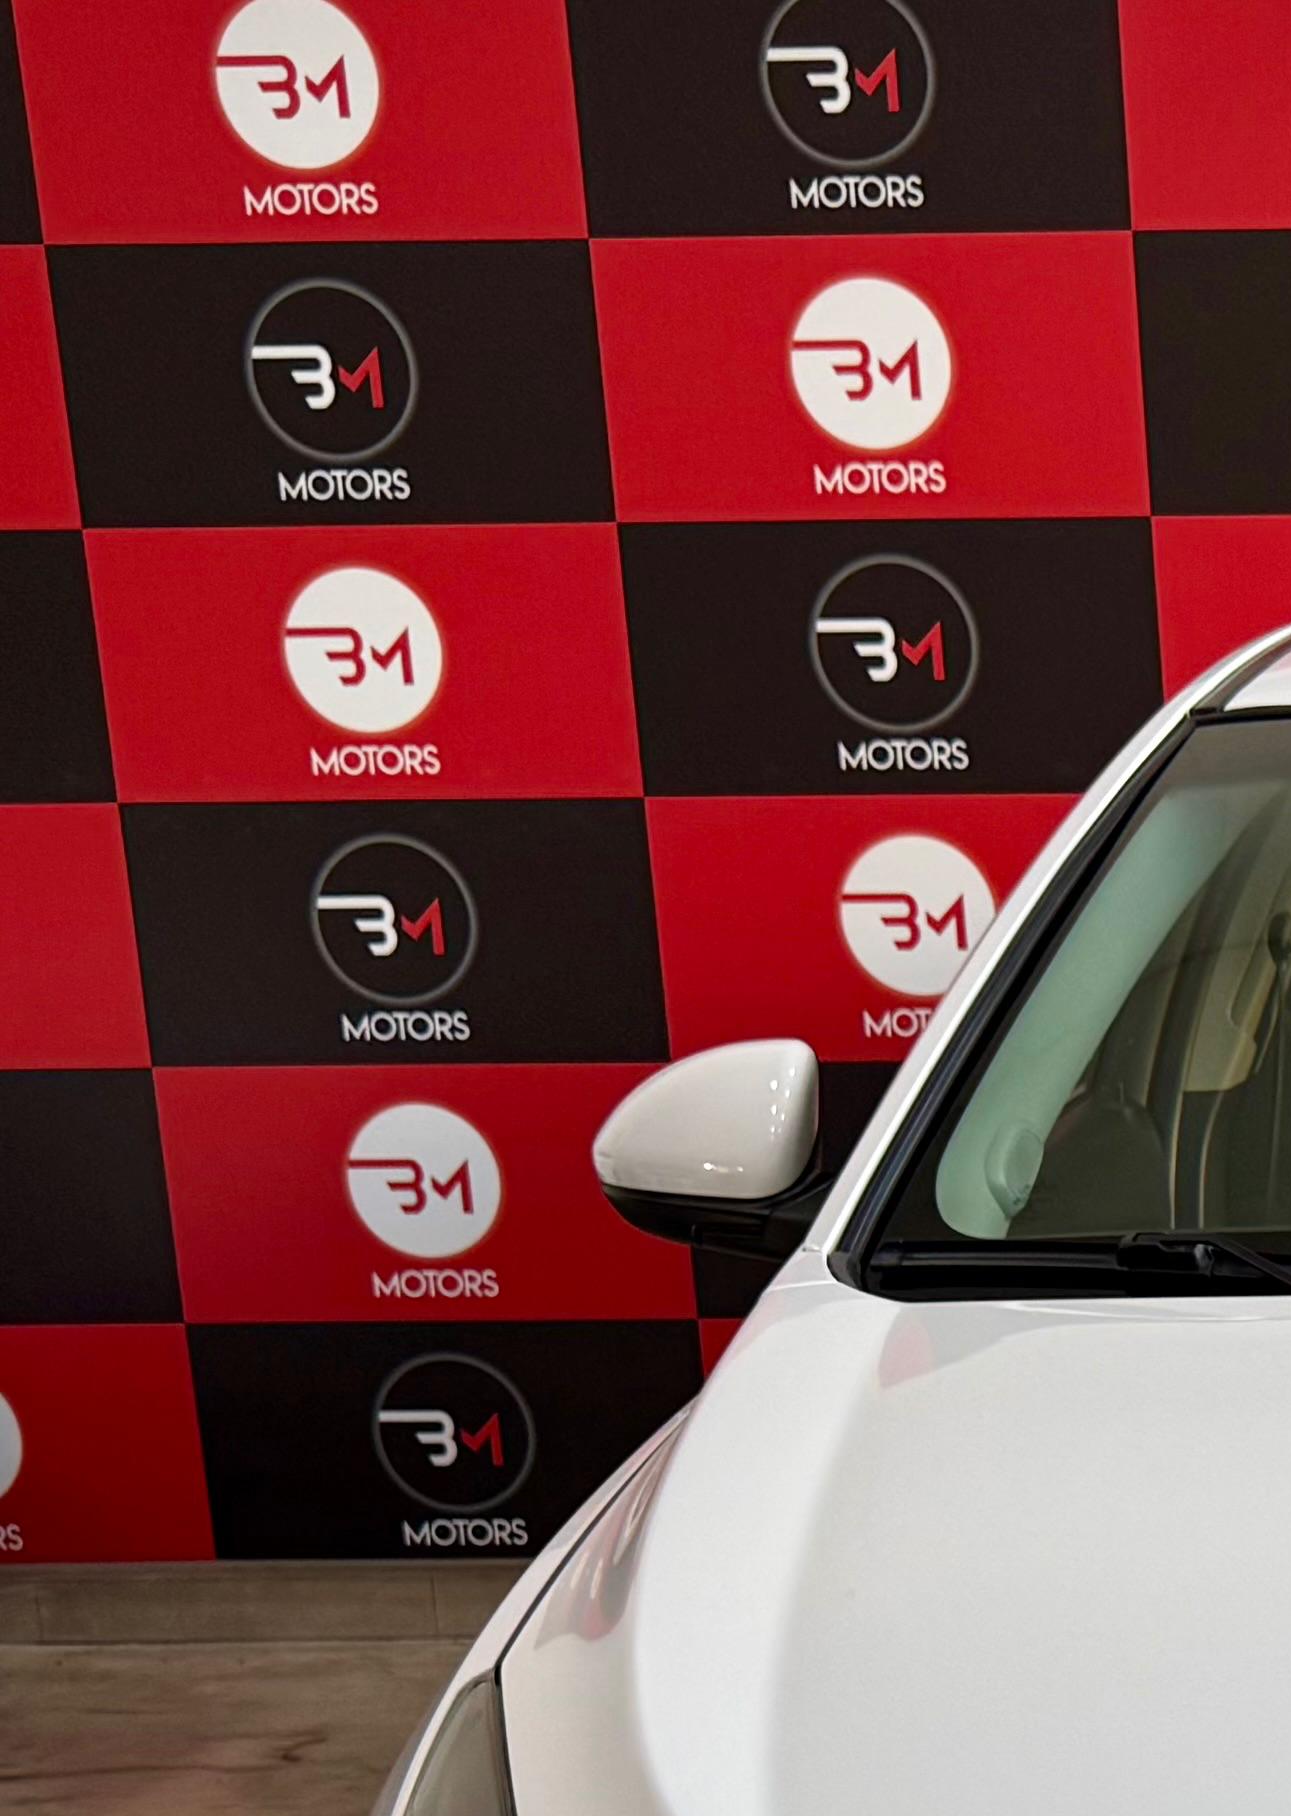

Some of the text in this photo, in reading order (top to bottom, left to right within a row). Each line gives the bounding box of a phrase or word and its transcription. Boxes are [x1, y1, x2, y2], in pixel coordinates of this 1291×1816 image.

[244, 183, 378, 215] MOTORS
[790, 175, 923, 208] MOTORS
[279, 469, 410, 500] MOTORS
[814, 461, 946, 494] MOTORS
[311, 745, 440, 775] MOTORS
[838, 739, 969, 770] MOTORS
[342, 1012, 470, 1041] MOTORS
[863, 1007, 932, 1038] MOT
[373, 1269, 499, 1297] MOTORS
[404, 1519, 528, 1546] MOTORS
